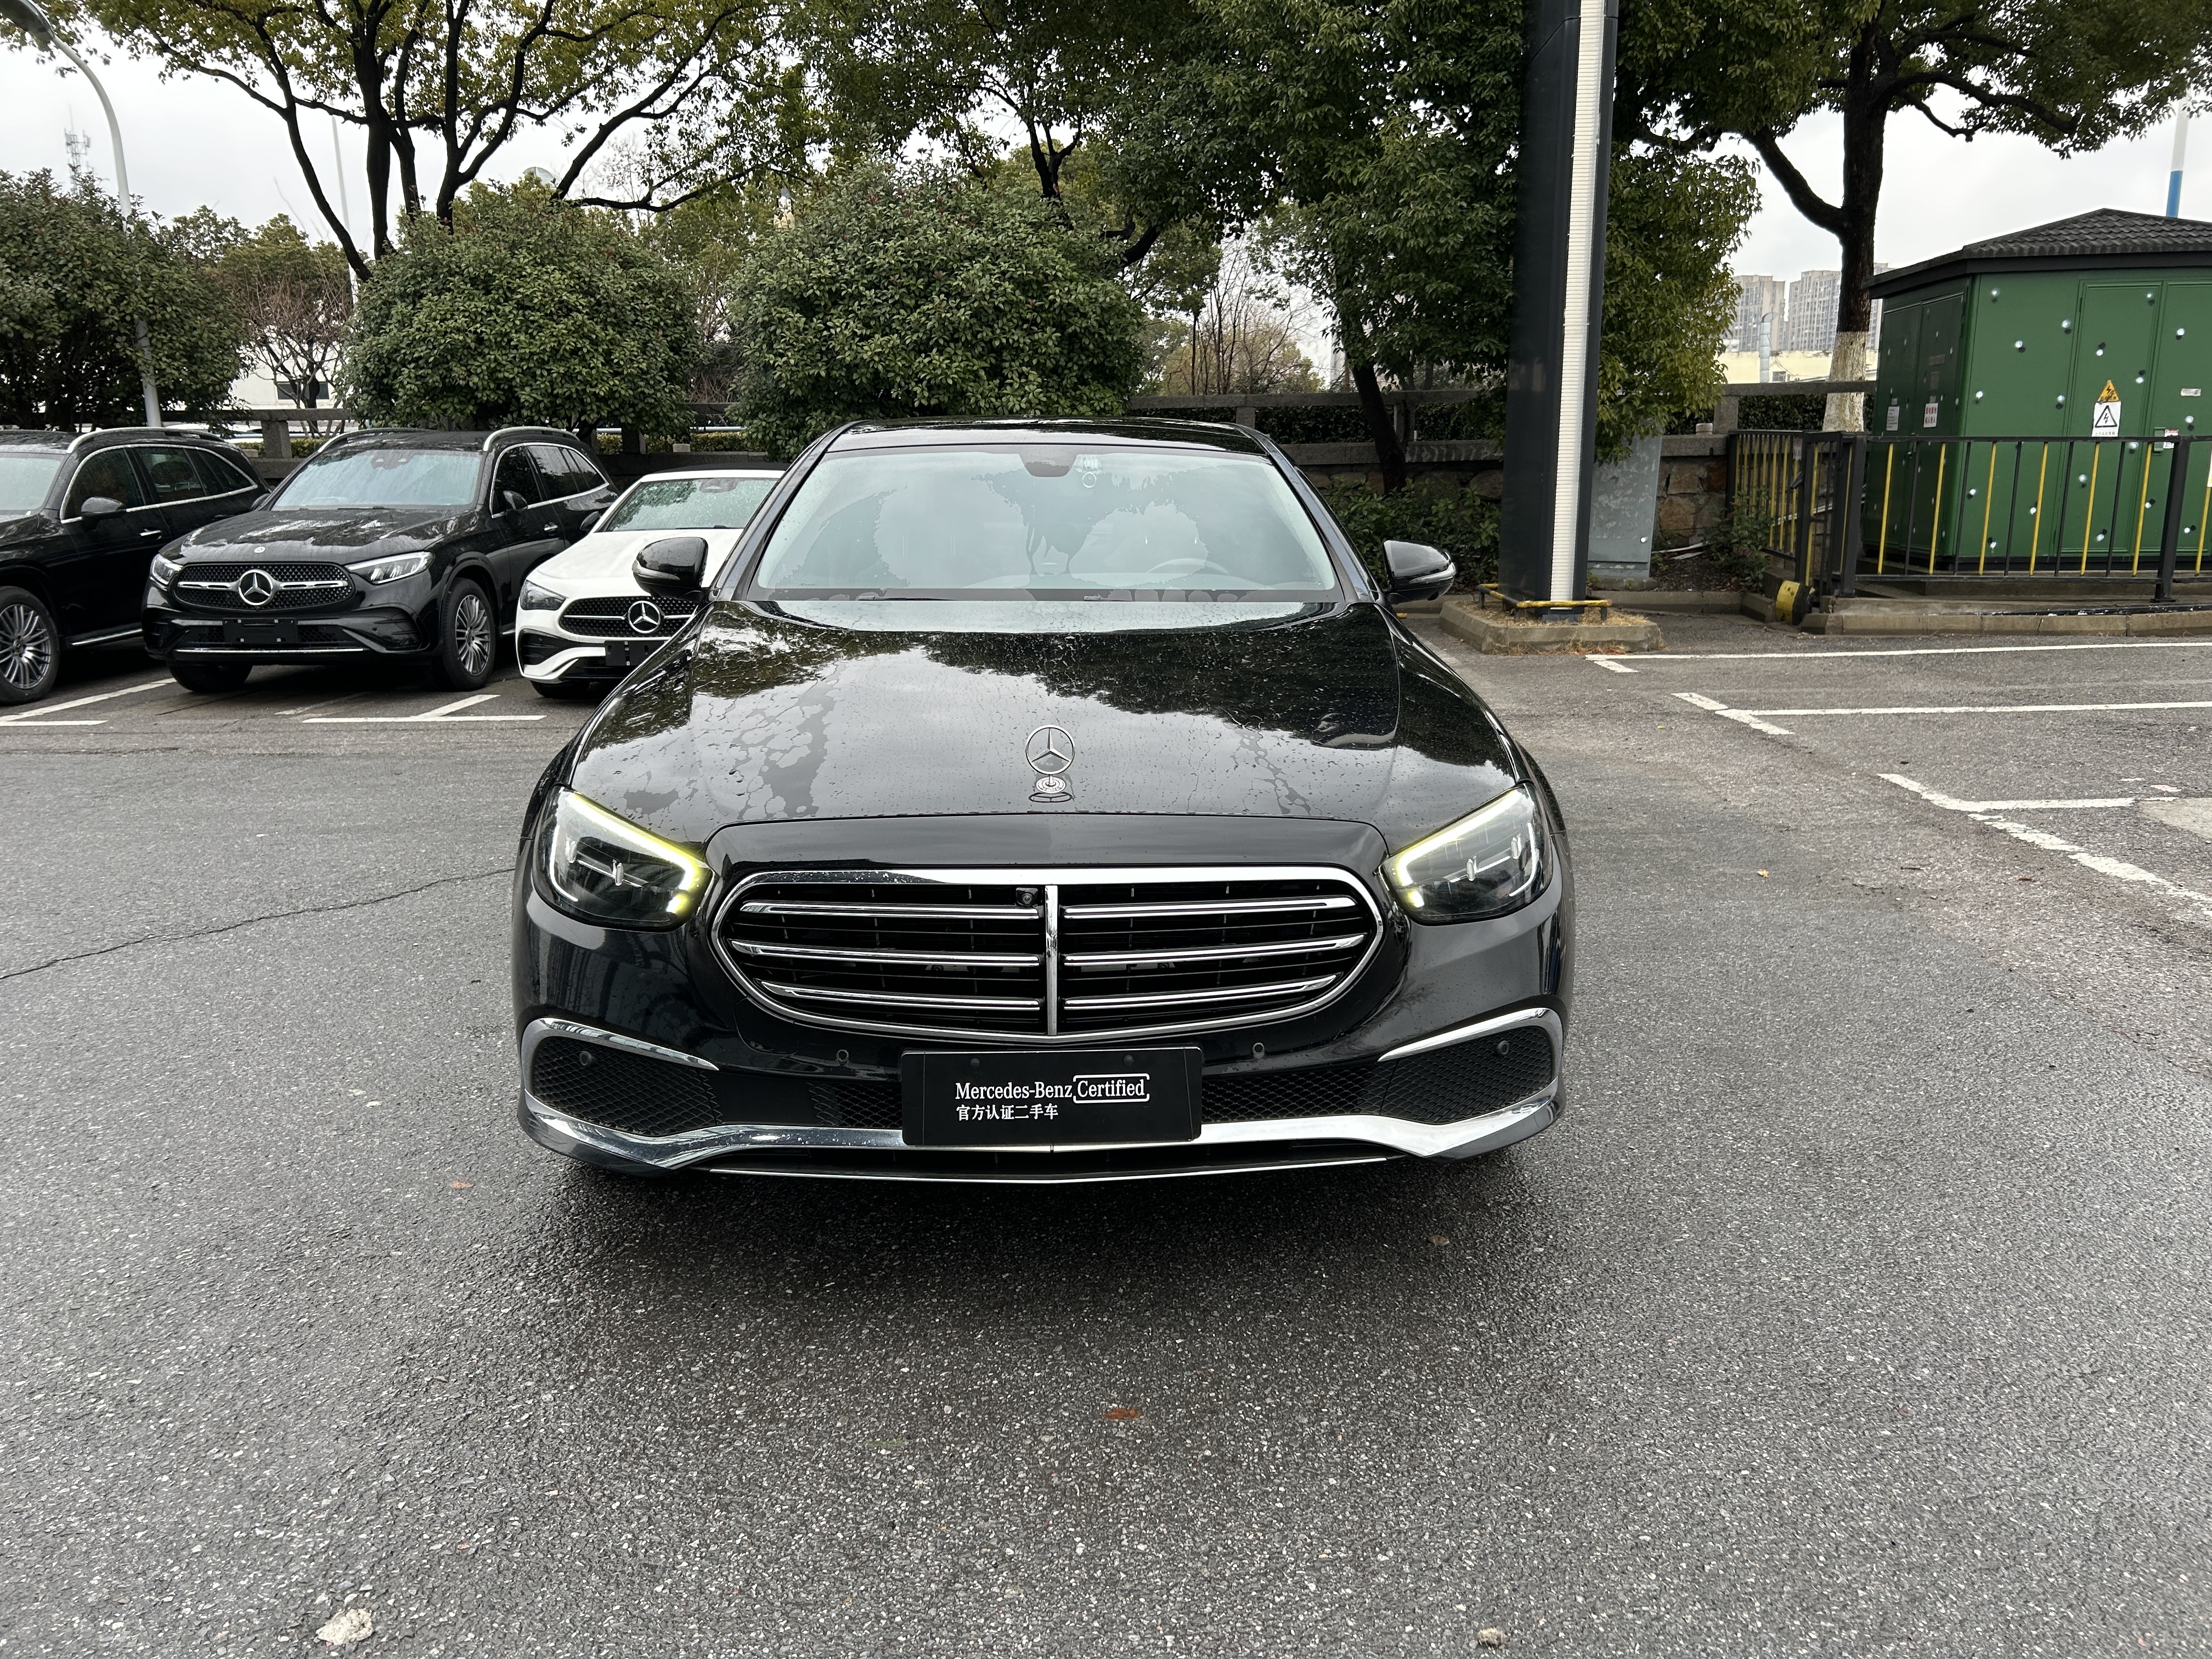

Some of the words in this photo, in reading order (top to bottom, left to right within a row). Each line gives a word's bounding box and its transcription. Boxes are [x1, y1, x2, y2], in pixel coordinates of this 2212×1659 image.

[955, 1082, 1073, 1099] Mercedes-Benz
[1077, 1079, 1145, 1098] Certified
[956, 1103, 1059, 1121] 官方认证二手车
